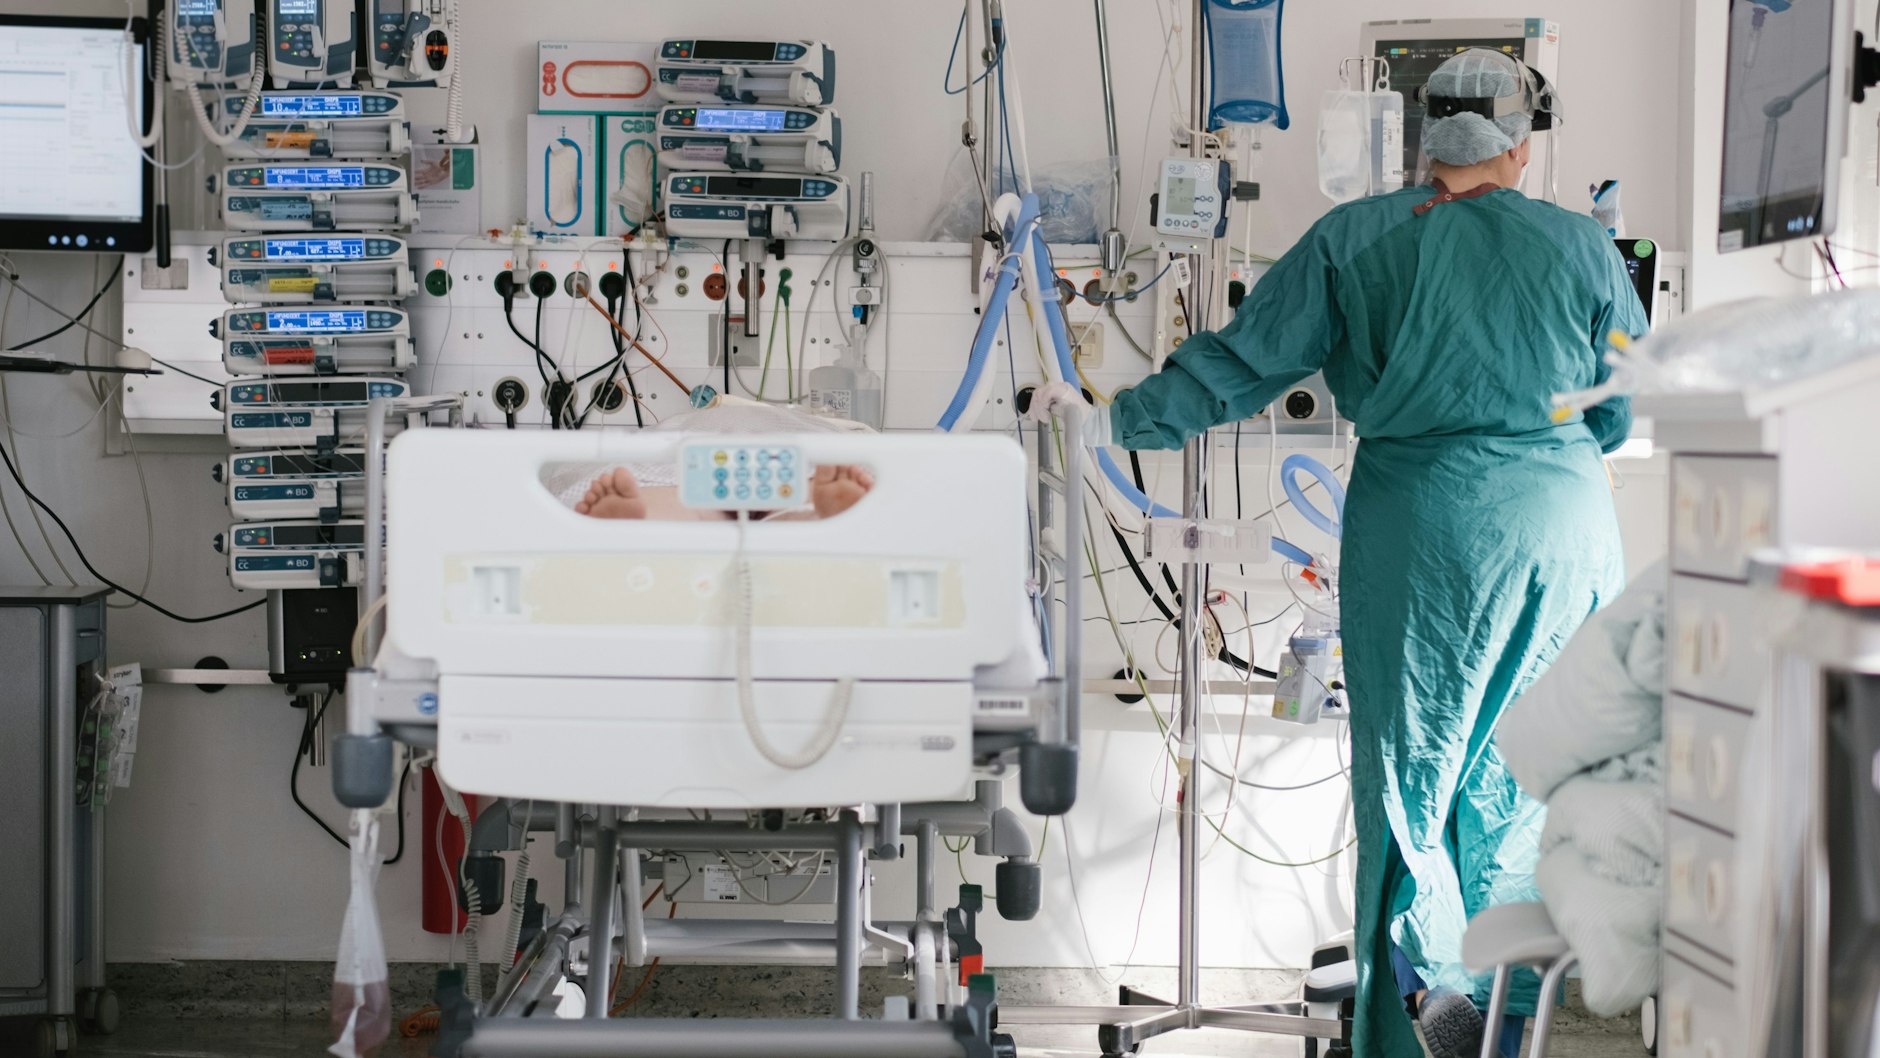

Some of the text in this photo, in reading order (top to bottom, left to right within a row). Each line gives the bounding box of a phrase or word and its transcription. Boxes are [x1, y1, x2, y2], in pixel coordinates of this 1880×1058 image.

[661, 73, 671, 81] CC
[727, 209, 740, 217] BD
[231, 275, 243, 283] CC
[233, 416, 305, 426] CC BD
[237, 488, 308, 499] CC BD
[238, 562, 249, 570] CC
[113, 669, 133, 679] stryker
